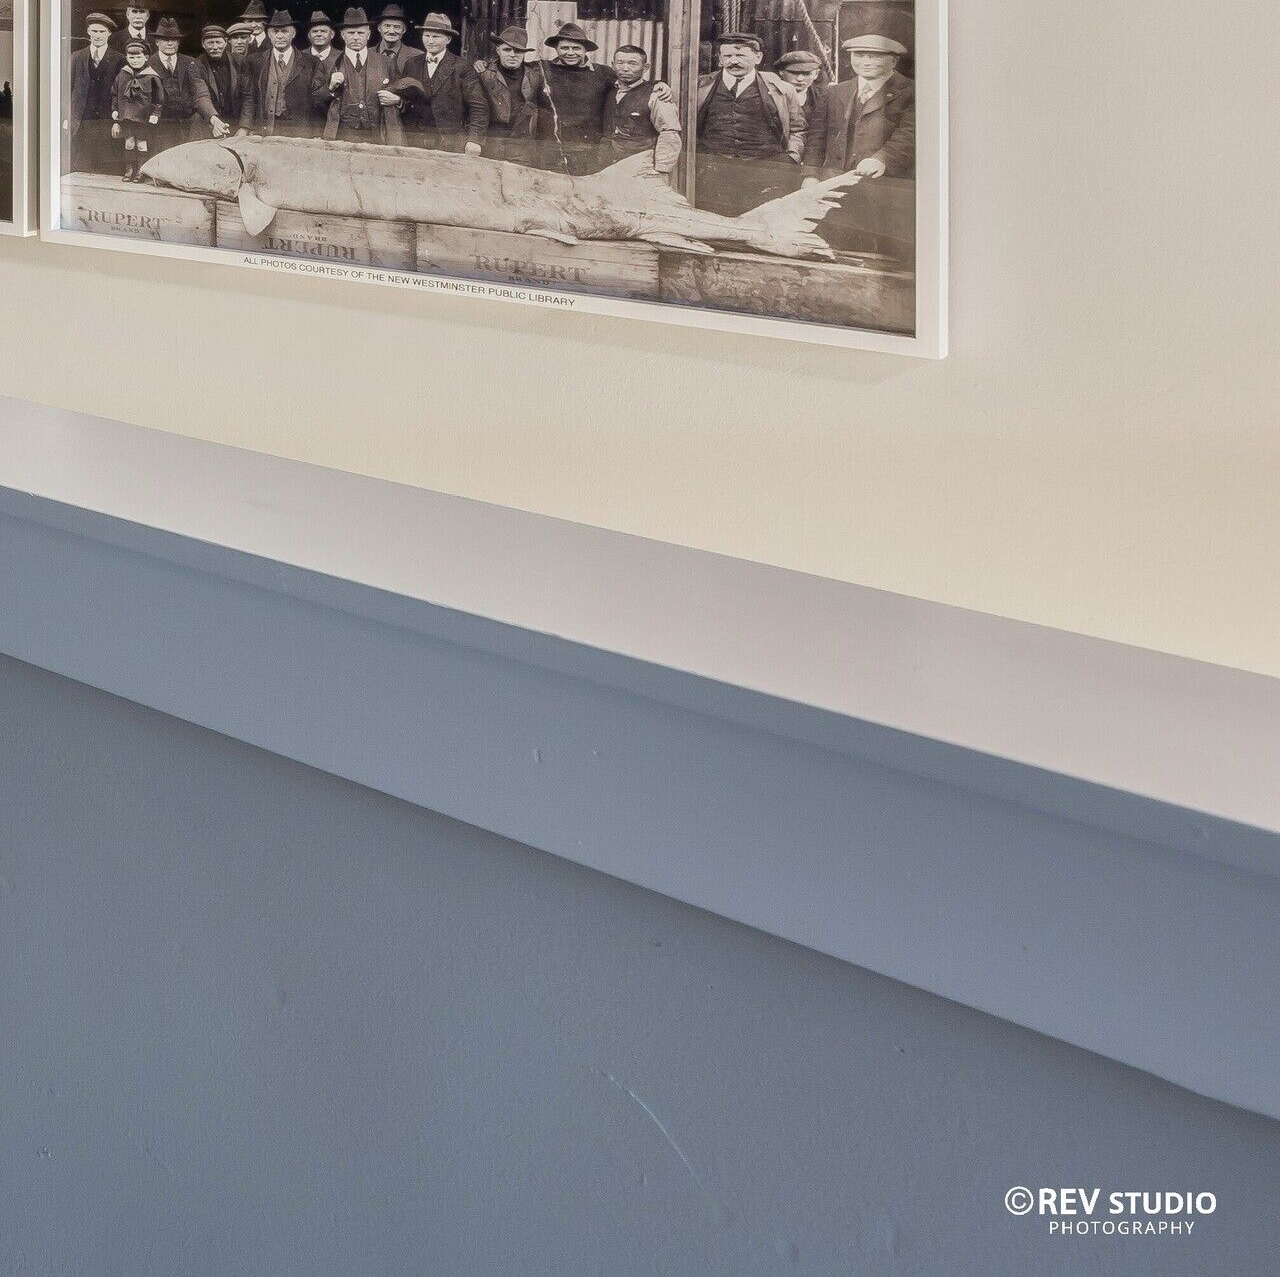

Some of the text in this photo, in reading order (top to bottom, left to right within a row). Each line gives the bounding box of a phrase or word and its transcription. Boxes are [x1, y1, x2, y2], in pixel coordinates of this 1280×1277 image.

[87, 209, 163, 230] RUPERT
[261, 237, 358, 261] RUPERT
[473, 255, 591, 282] RUPERT
[243, 256, 576, 307] ALL PHOTOS COURTESY OF THE NEW WESTMINSTER PUBLIC LIBRARY
